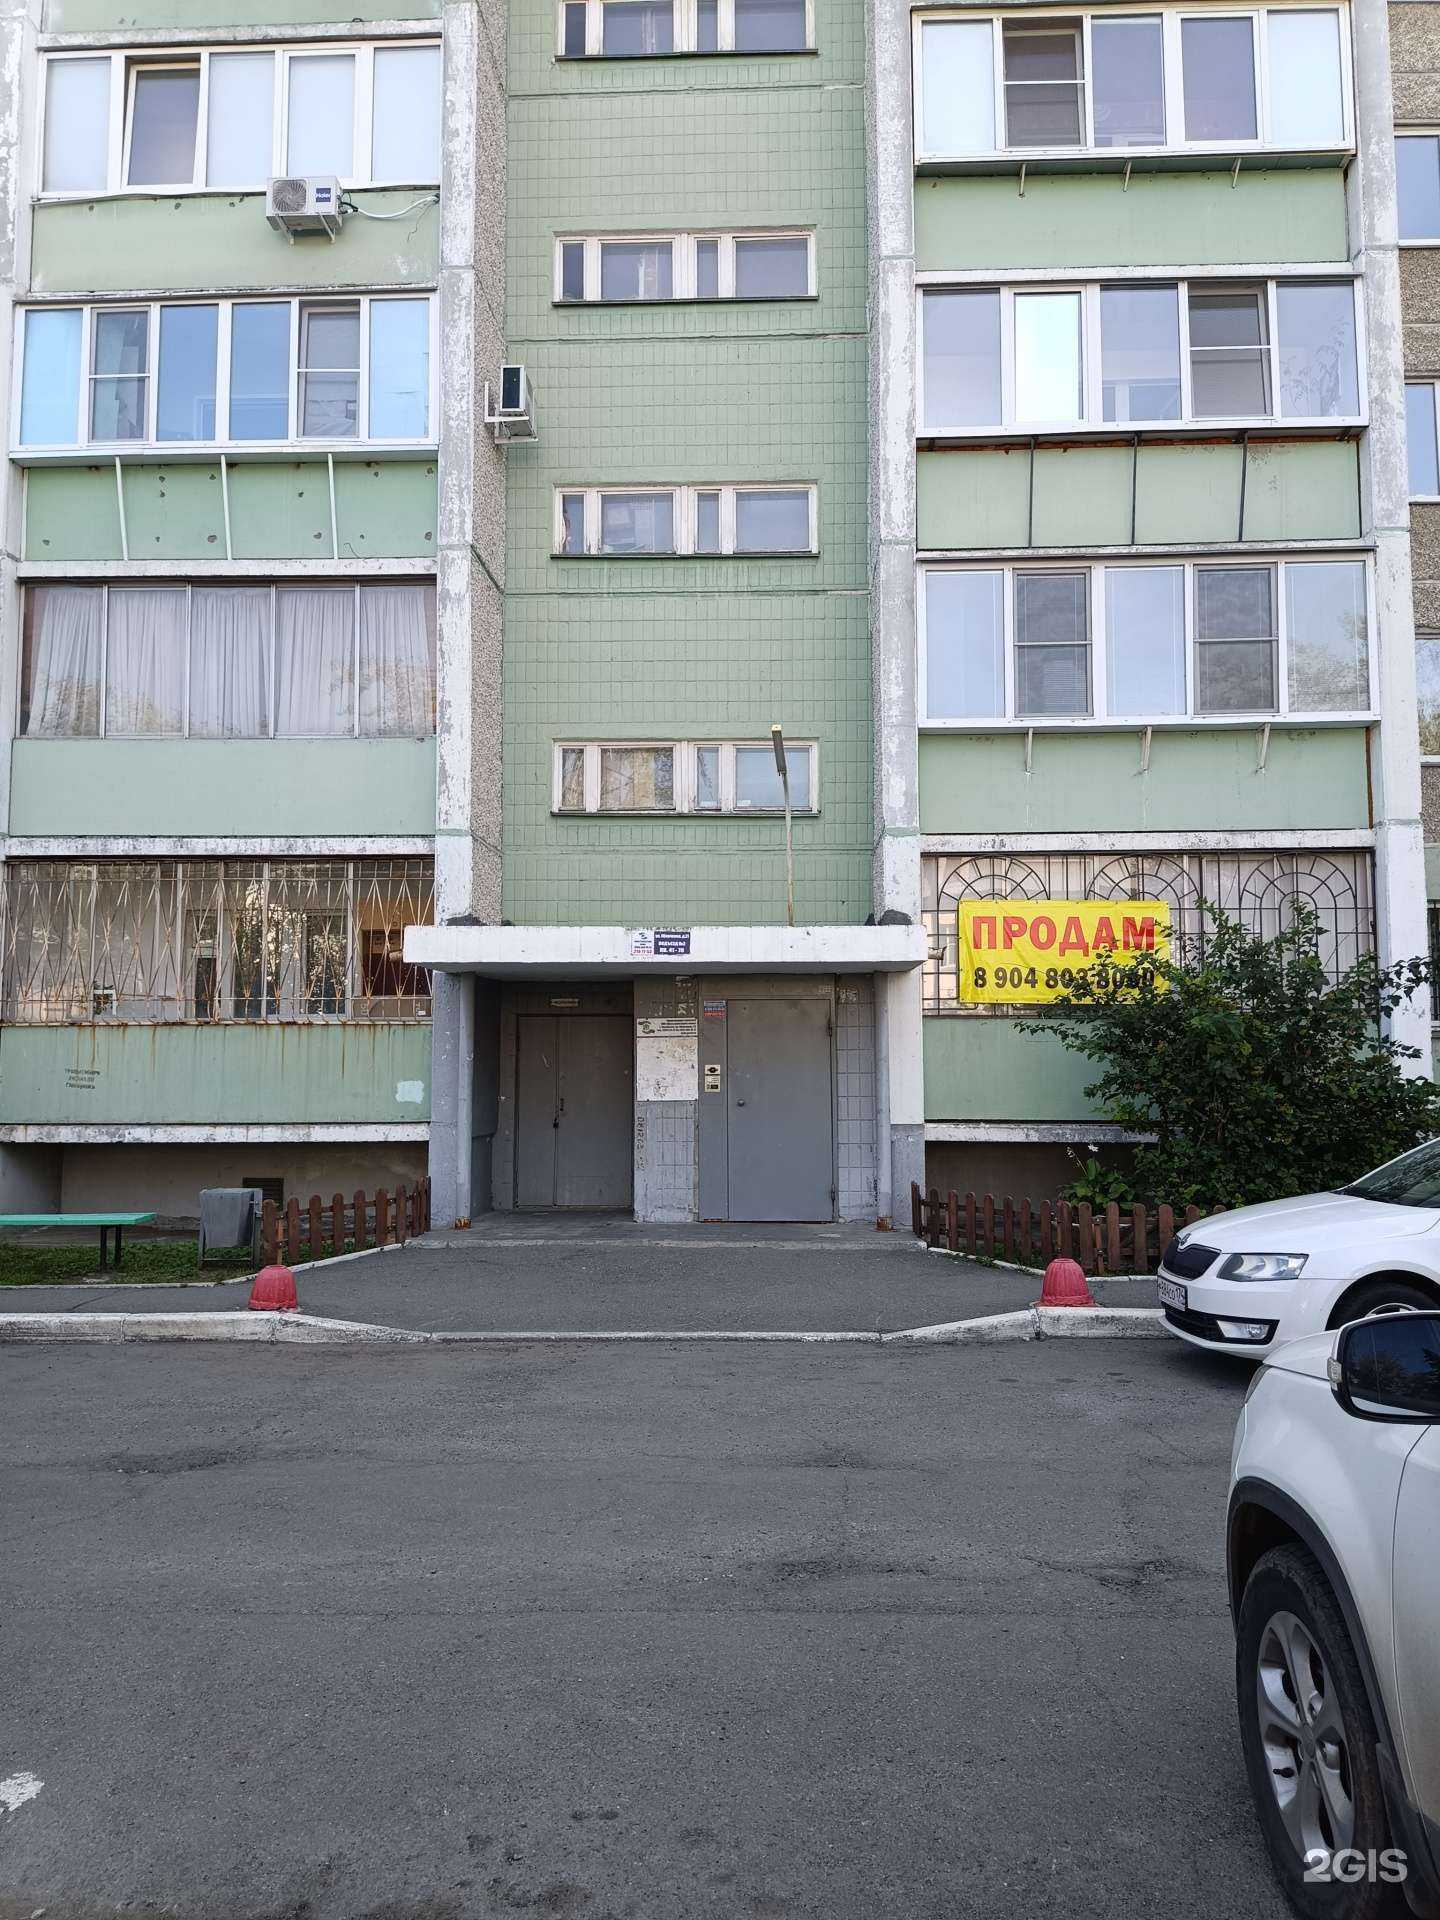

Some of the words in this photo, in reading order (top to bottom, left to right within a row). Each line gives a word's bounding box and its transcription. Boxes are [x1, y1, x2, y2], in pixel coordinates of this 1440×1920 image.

[972, 916, 1155, 957] ПРОДАМ
[974, 967, 987, 989] 8
[994, 967, 1039, 989] 904
